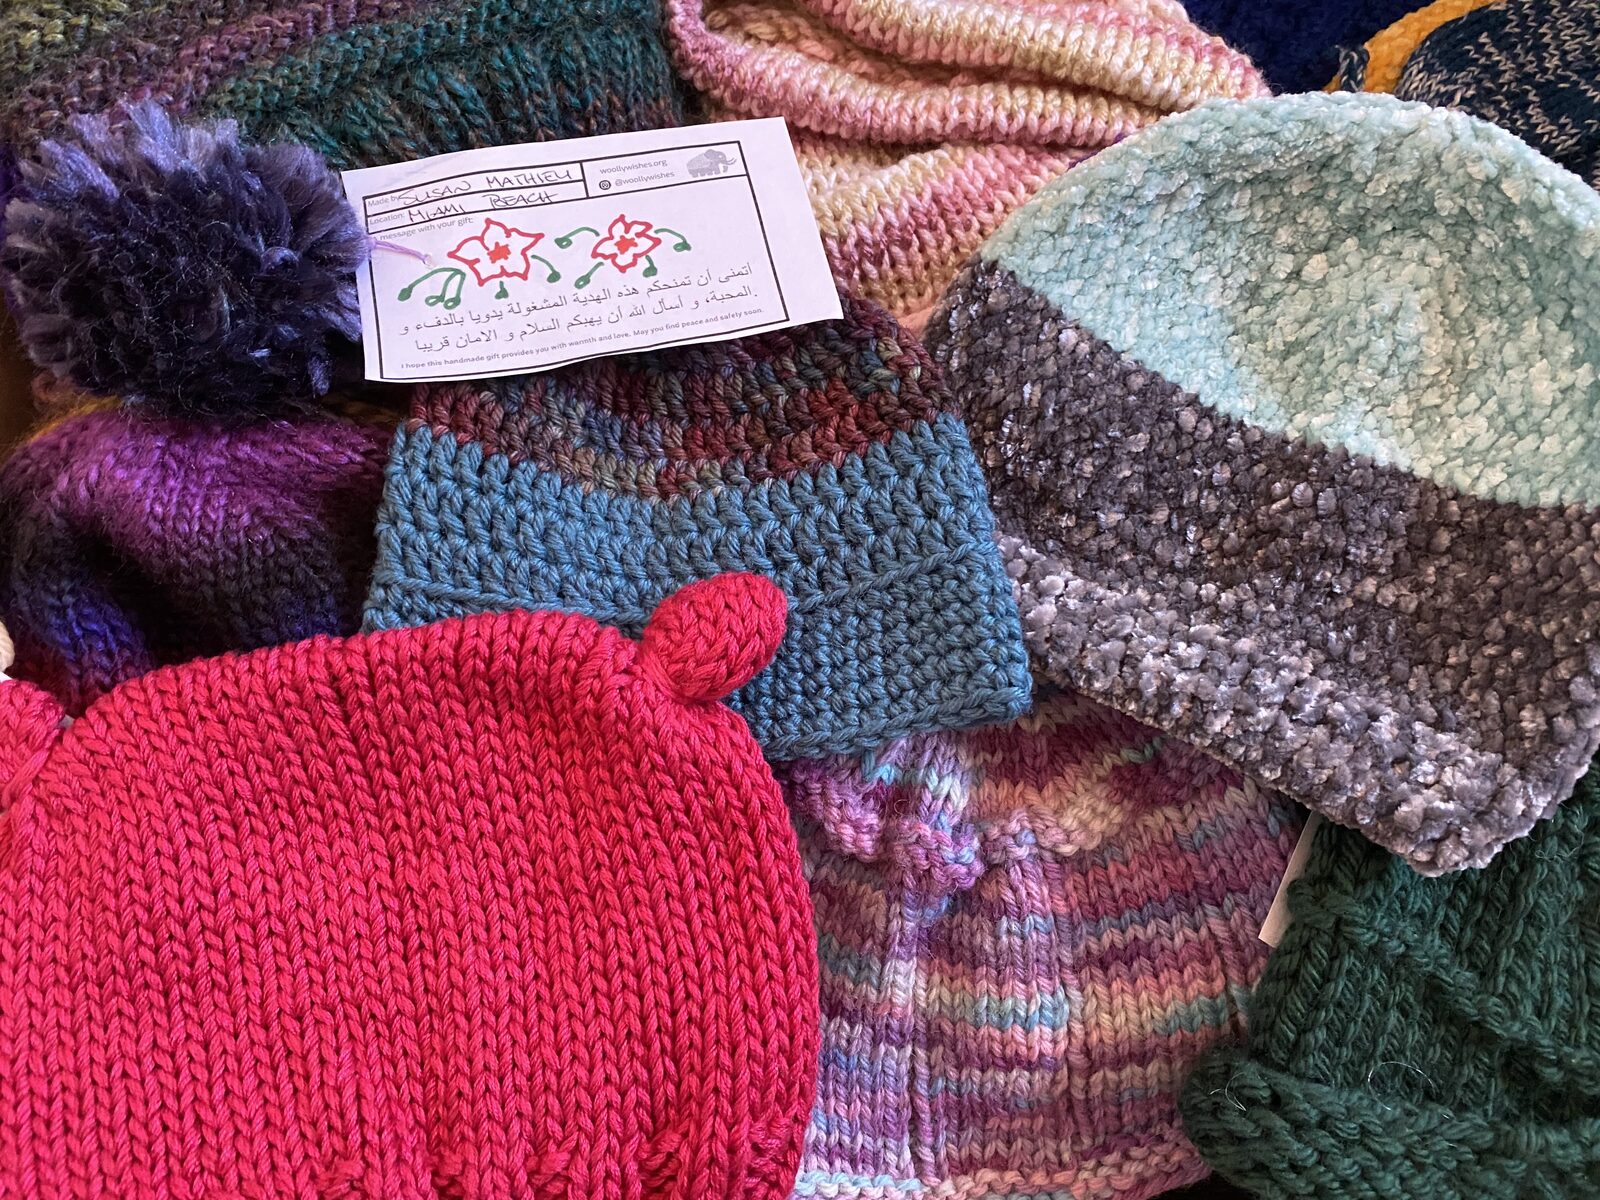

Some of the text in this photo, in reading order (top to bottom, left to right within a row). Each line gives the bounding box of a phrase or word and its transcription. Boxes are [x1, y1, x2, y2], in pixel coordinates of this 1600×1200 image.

[600, 159, 668, 175] woollywishes.org
[614, 170, 675, 187] @woollywishes
[398, 169, 572, 206] SUSAN MATHIEU
[368, 198, 390, 207] Made
[408, 191, 558, 222] MIAMI BEACH
[370, 212, 405, 225] Location:
[380, 229, 416, 240] message
[418, 223, 436, 232] with
[436, 220, 456, 230] your
[697, 269, 712, 286] أن
[617, 284, 639, 298] هذه
[646, 276, 692, 298] تمنحكم
[508, 295, 568, 316] المشغولة
[573, 288, 611, 306] الهدية
[691, 300, 700, 310] و
[468, 310, 503, 324] يدويا
[608, 305, 622, 324] أن
[629, 304, 646, 318] الله
[416, 313, 464, 330] بالدفء
[520, 318, 560, 341] السلام
[566, 314, 602, 332] يهبكم
[400, 326, 409, 336] و
[504, 332, 514, 342] و
[406, 361, 426, 370] hope
[444, 355, 484, 365] handmade
[486, 353, 500, 361] gift
[502, 348, 534, 359] provides
[536, 347, 549, 355] you
[551, 342, 567, 350] with
[569, 337, 596, 347] warmth
[598, 334, 612, 342] and
[650, 326, 664, 334] you
[682, 320, 703, 328] peace
[720, 312, 742, 321] safety
[415, 336, 450, 352] قريبا
